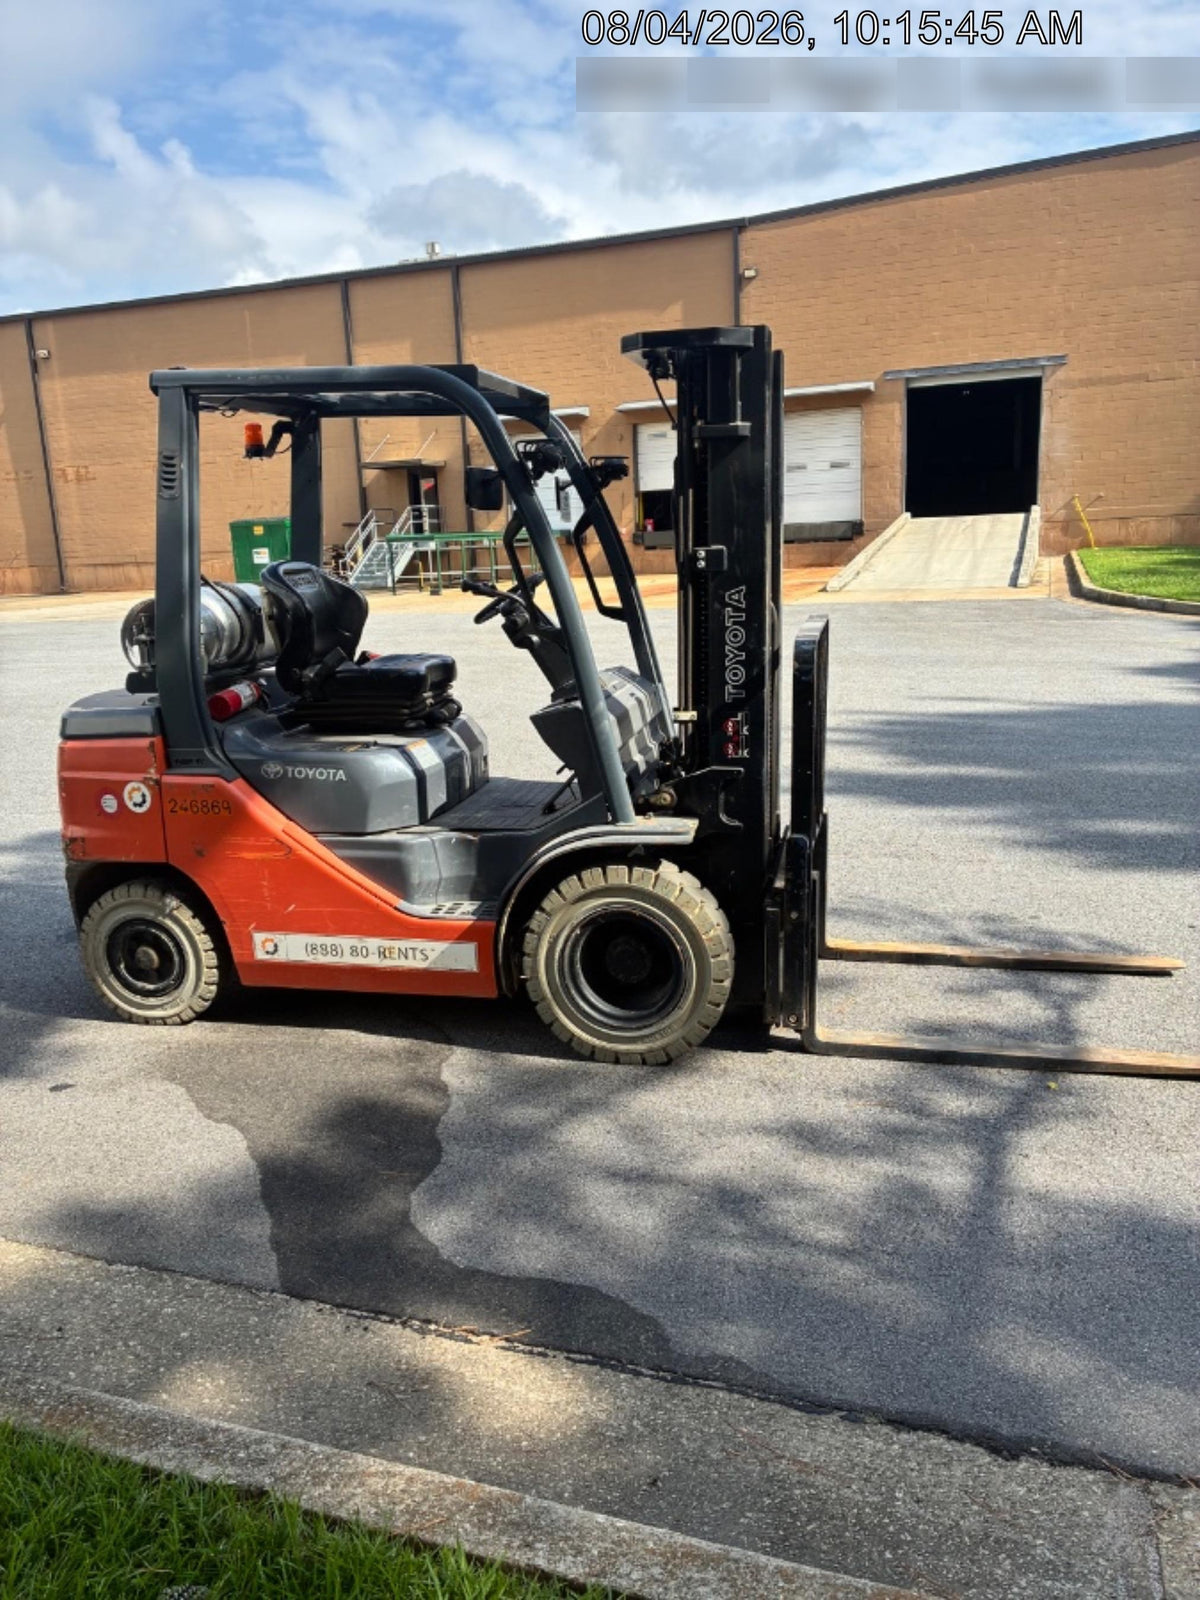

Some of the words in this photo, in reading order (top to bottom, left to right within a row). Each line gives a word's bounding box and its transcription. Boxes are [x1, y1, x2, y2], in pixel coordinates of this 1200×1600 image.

[725, 585, 746, 703] TOYOTA
[285, 766, 347, 781] TOYOTA
[305, 942, 344, 958] (888)
